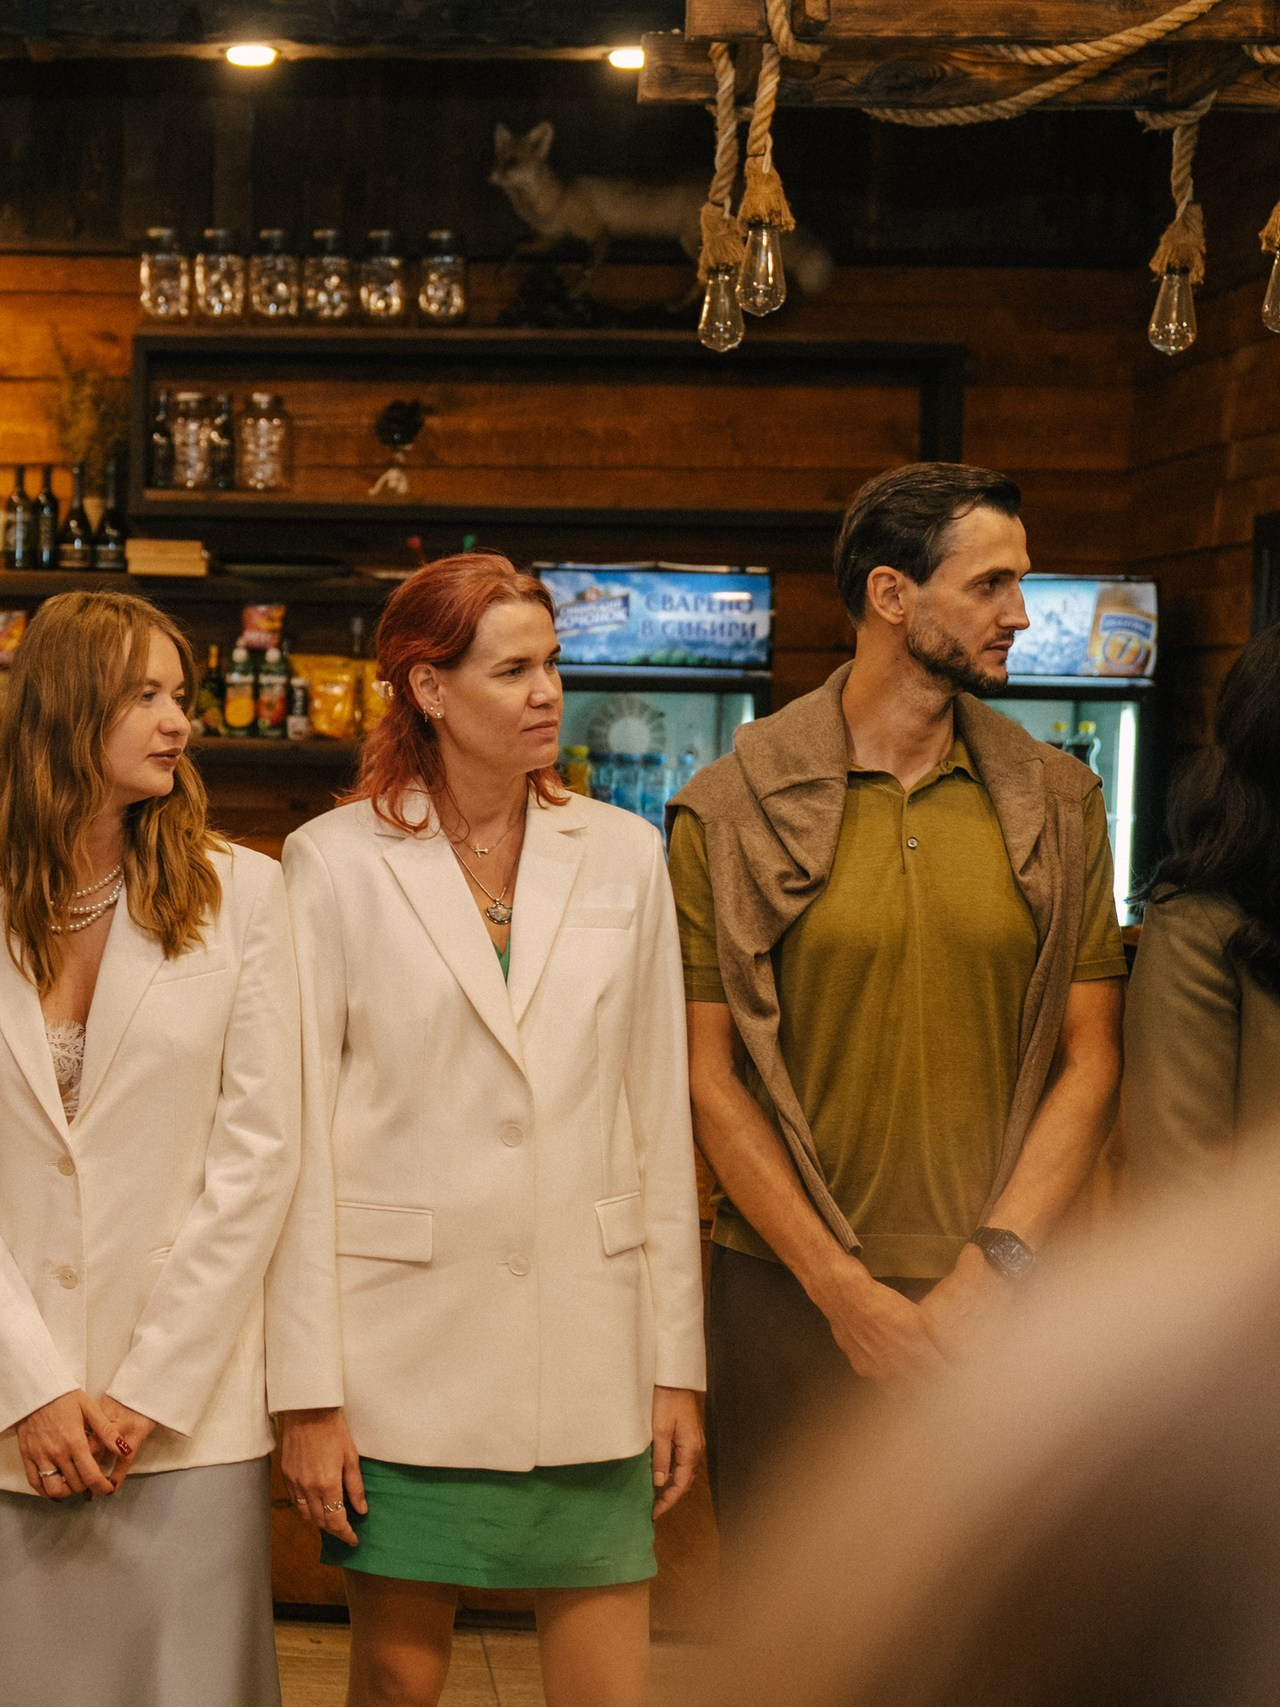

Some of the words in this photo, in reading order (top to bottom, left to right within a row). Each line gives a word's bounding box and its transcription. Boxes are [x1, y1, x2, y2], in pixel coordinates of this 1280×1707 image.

[644, 590, 755, 615] СВАРЕНО
[640, 619, 654, 637] В
[661, 619, 757, 640] СИБИРИ
